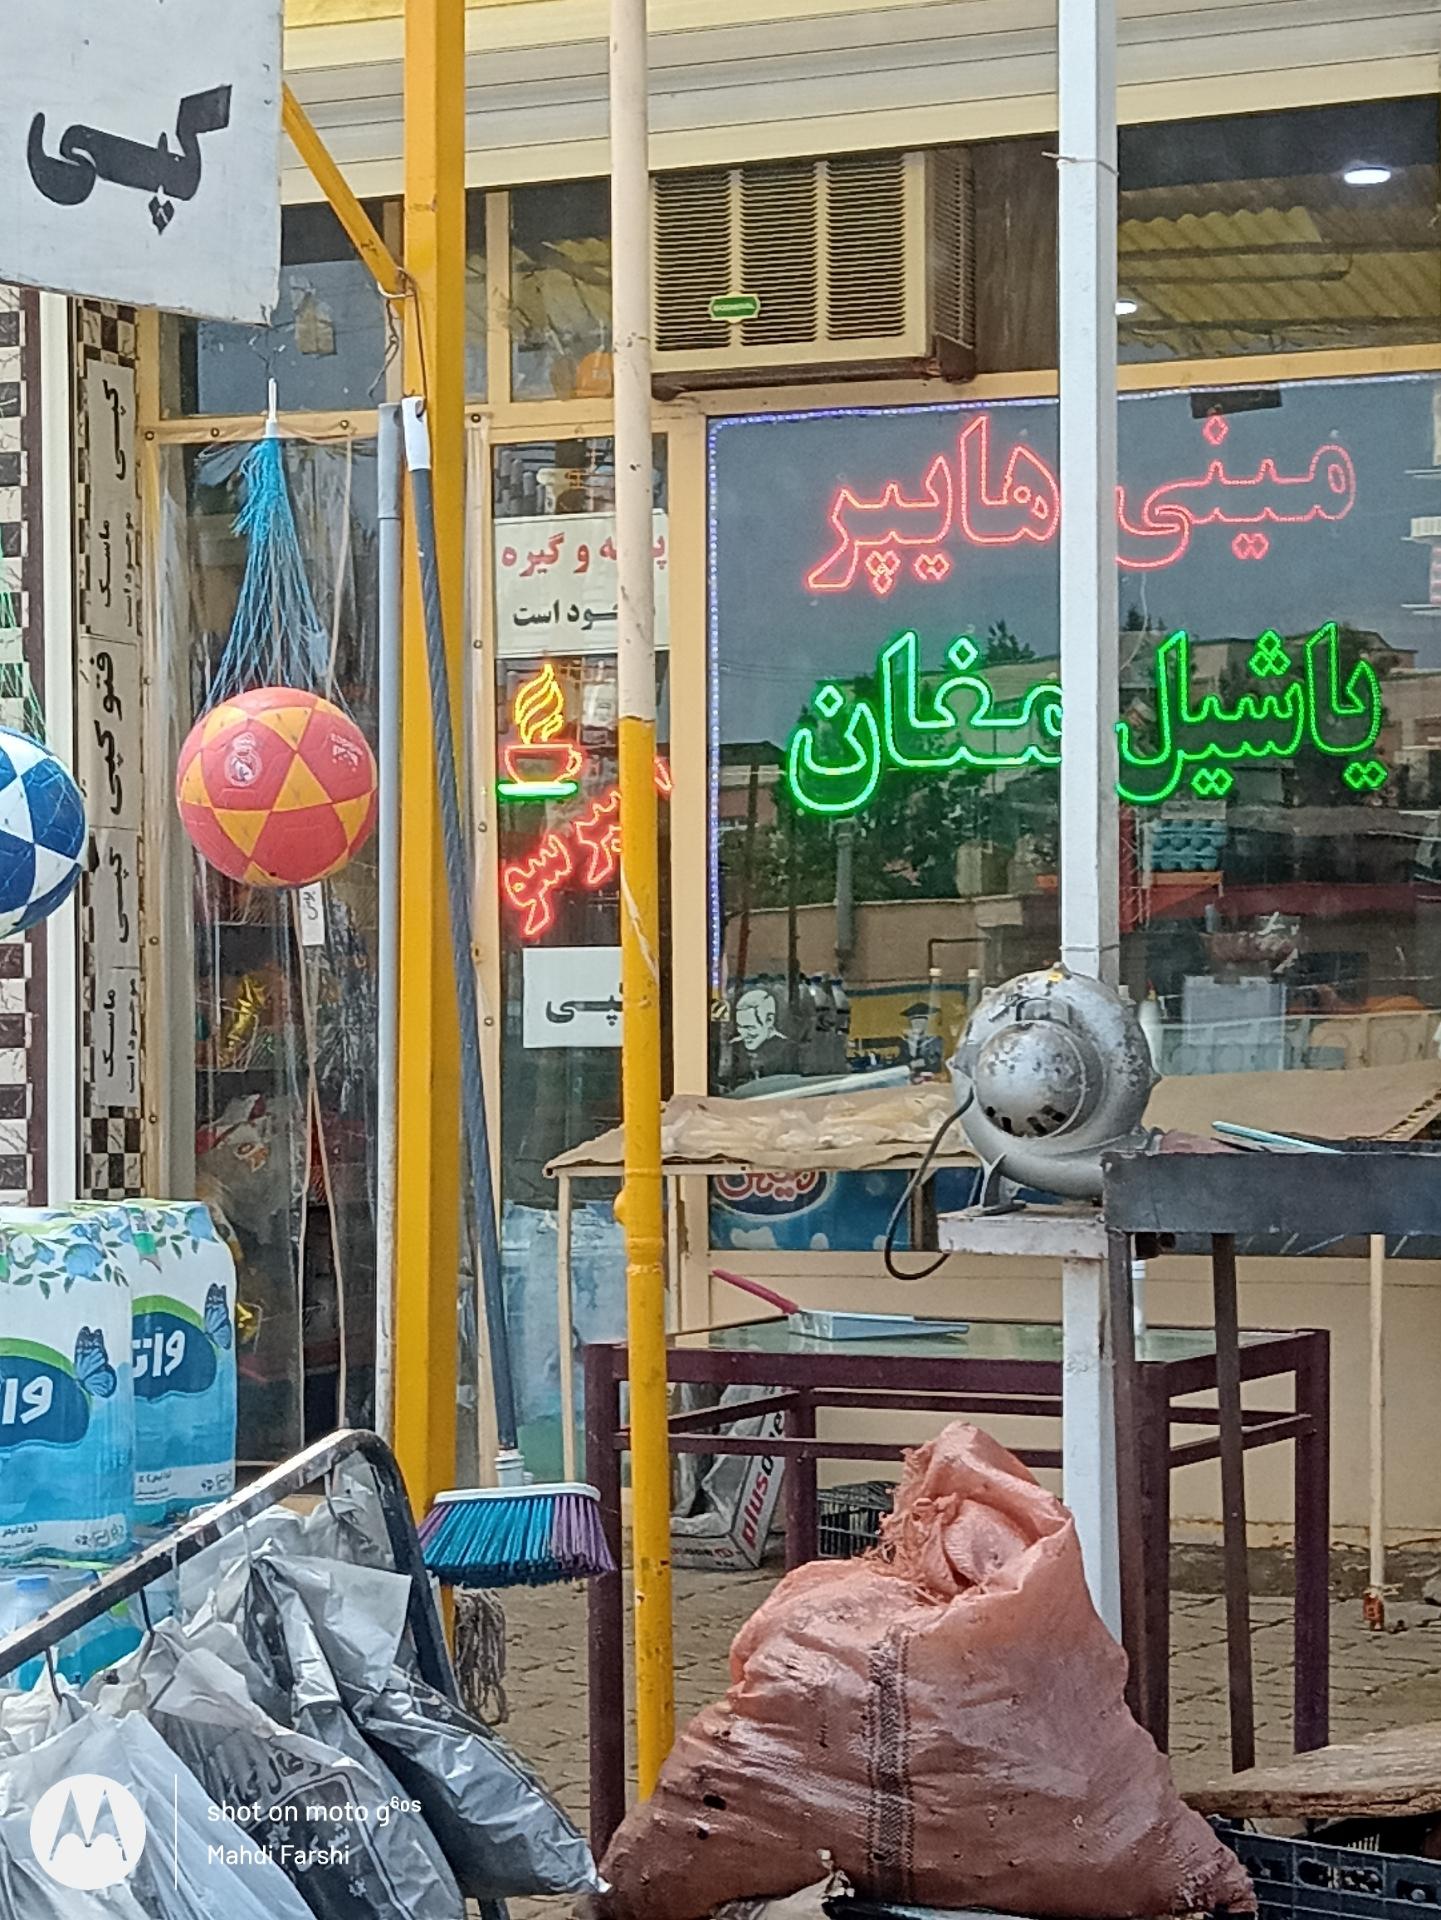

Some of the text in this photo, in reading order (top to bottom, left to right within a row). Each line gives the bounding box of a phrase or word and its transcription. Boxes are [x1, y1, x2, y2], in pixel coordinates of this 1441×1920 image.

[27, 84, 232, 235] کپی
[807, 414, 1356, 594] مینی هایپر
[1115, 620, 1388, 802] یاشیل
